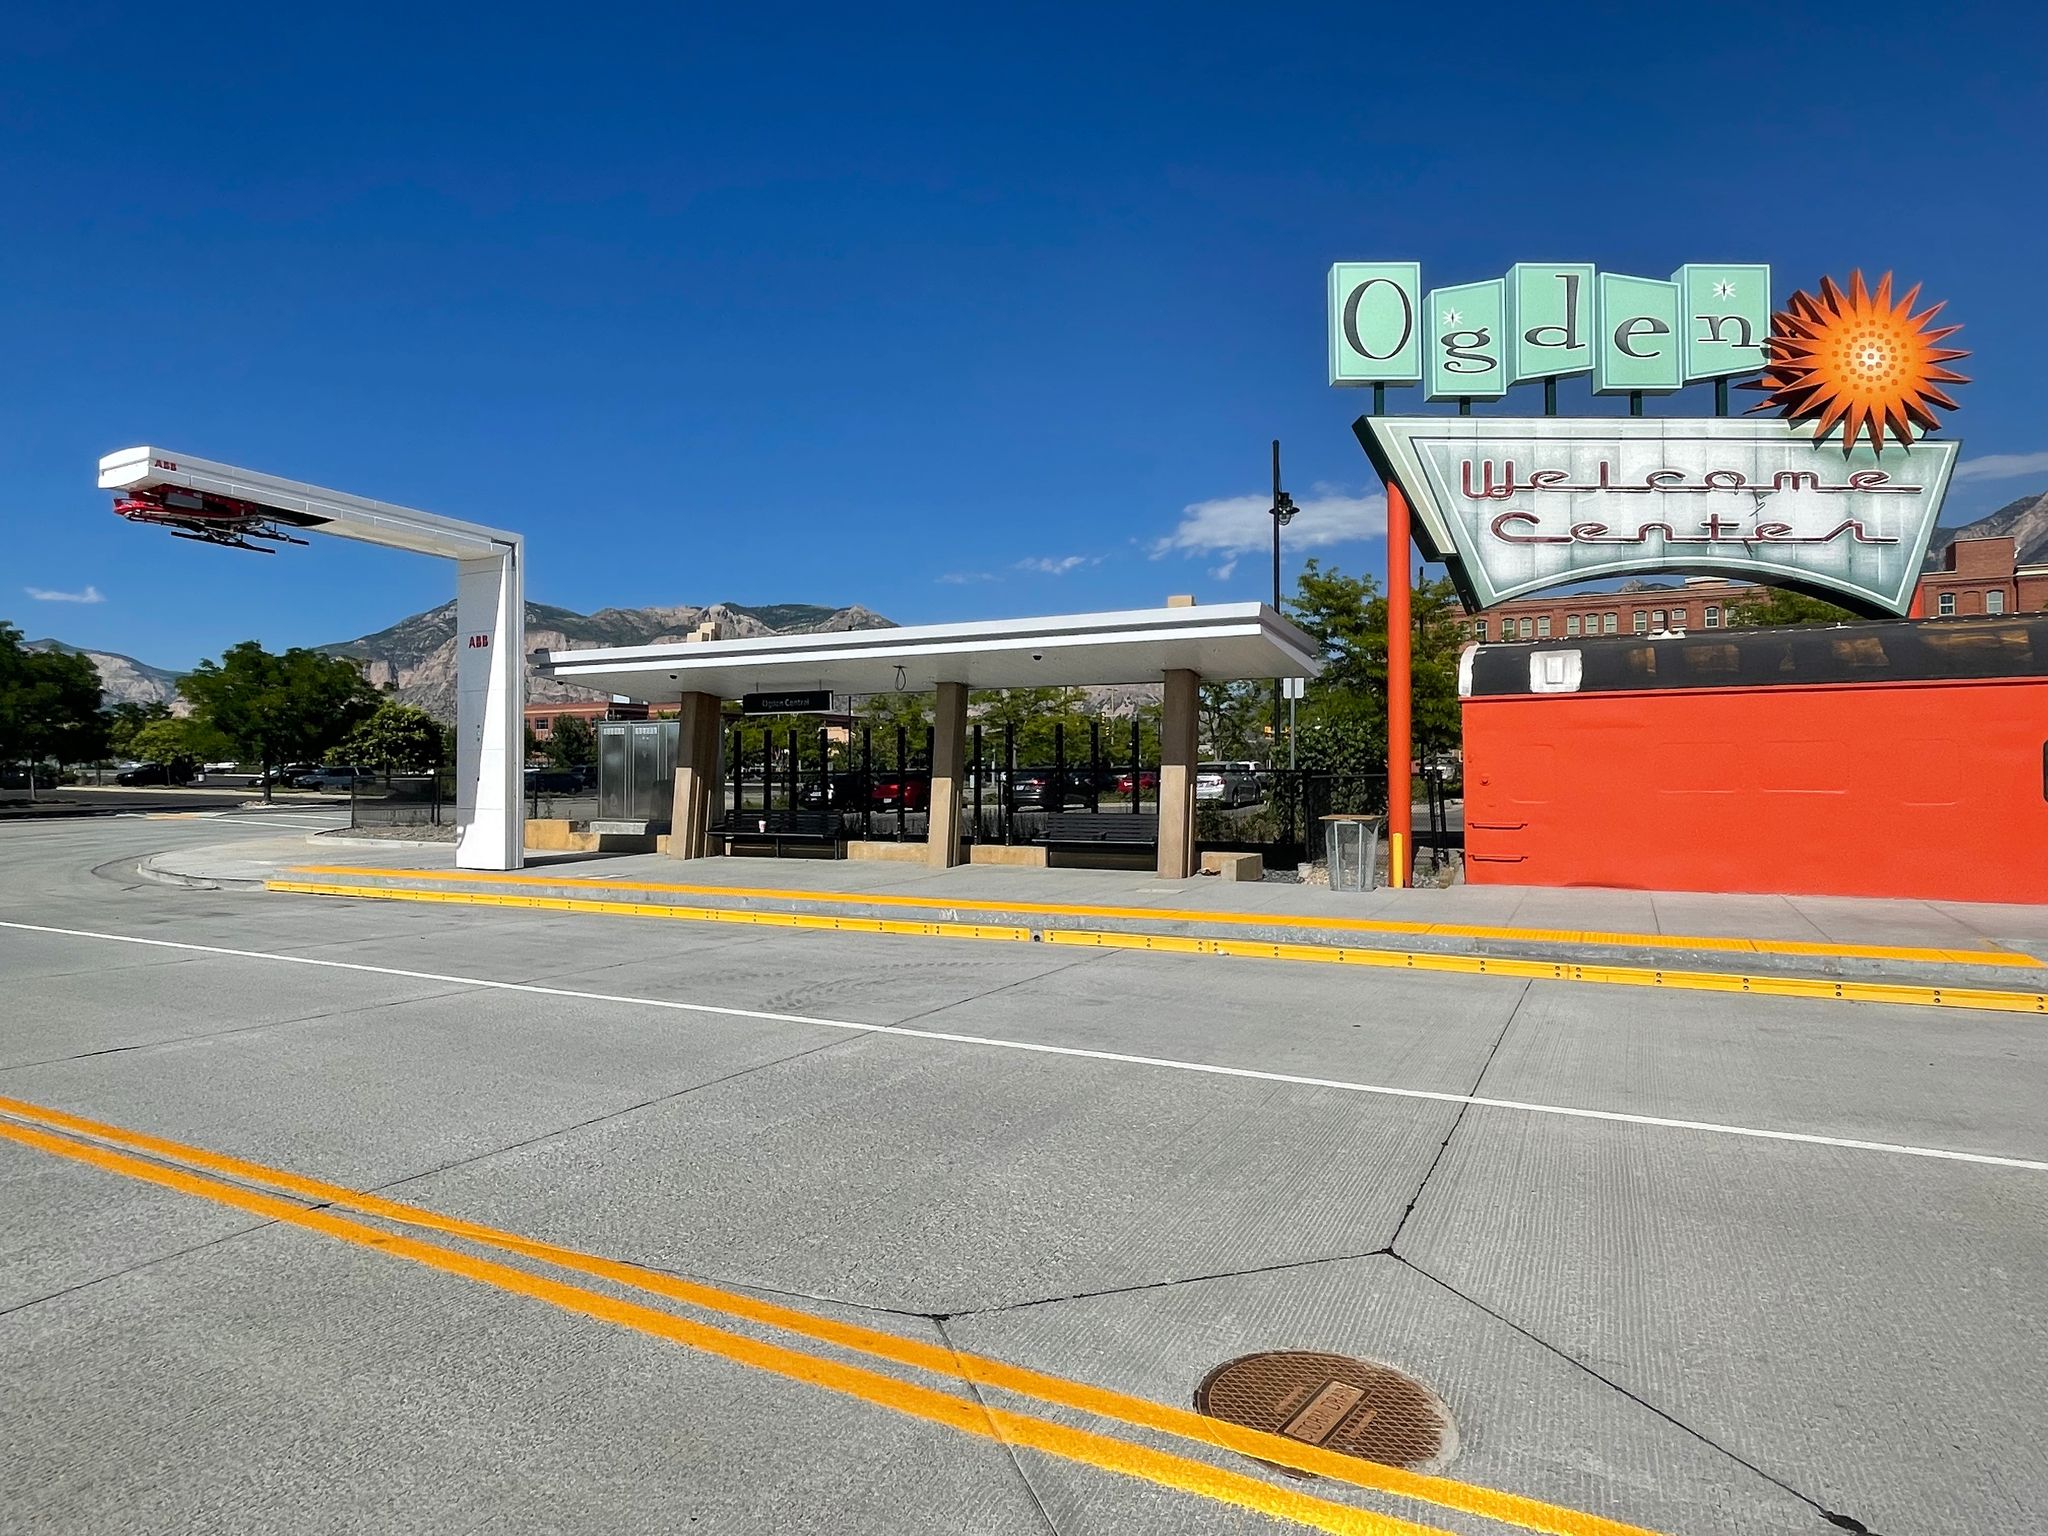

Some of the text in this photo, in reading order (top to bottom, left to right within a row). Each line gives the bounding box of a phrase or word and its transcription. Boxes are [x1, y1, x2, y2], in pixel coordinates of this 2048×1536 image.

[1343, 274, 1762, 374] Ogden
[154, 459, 177, 471] ABB
[1461, 459, 1923, 500] Welcome
[1490, 511, 1901, 545] Center
[468, 634, 489, 648] ABB
[784, 698, 810, 707] Central
[1293, 1409, 1333, 1440] STORM
